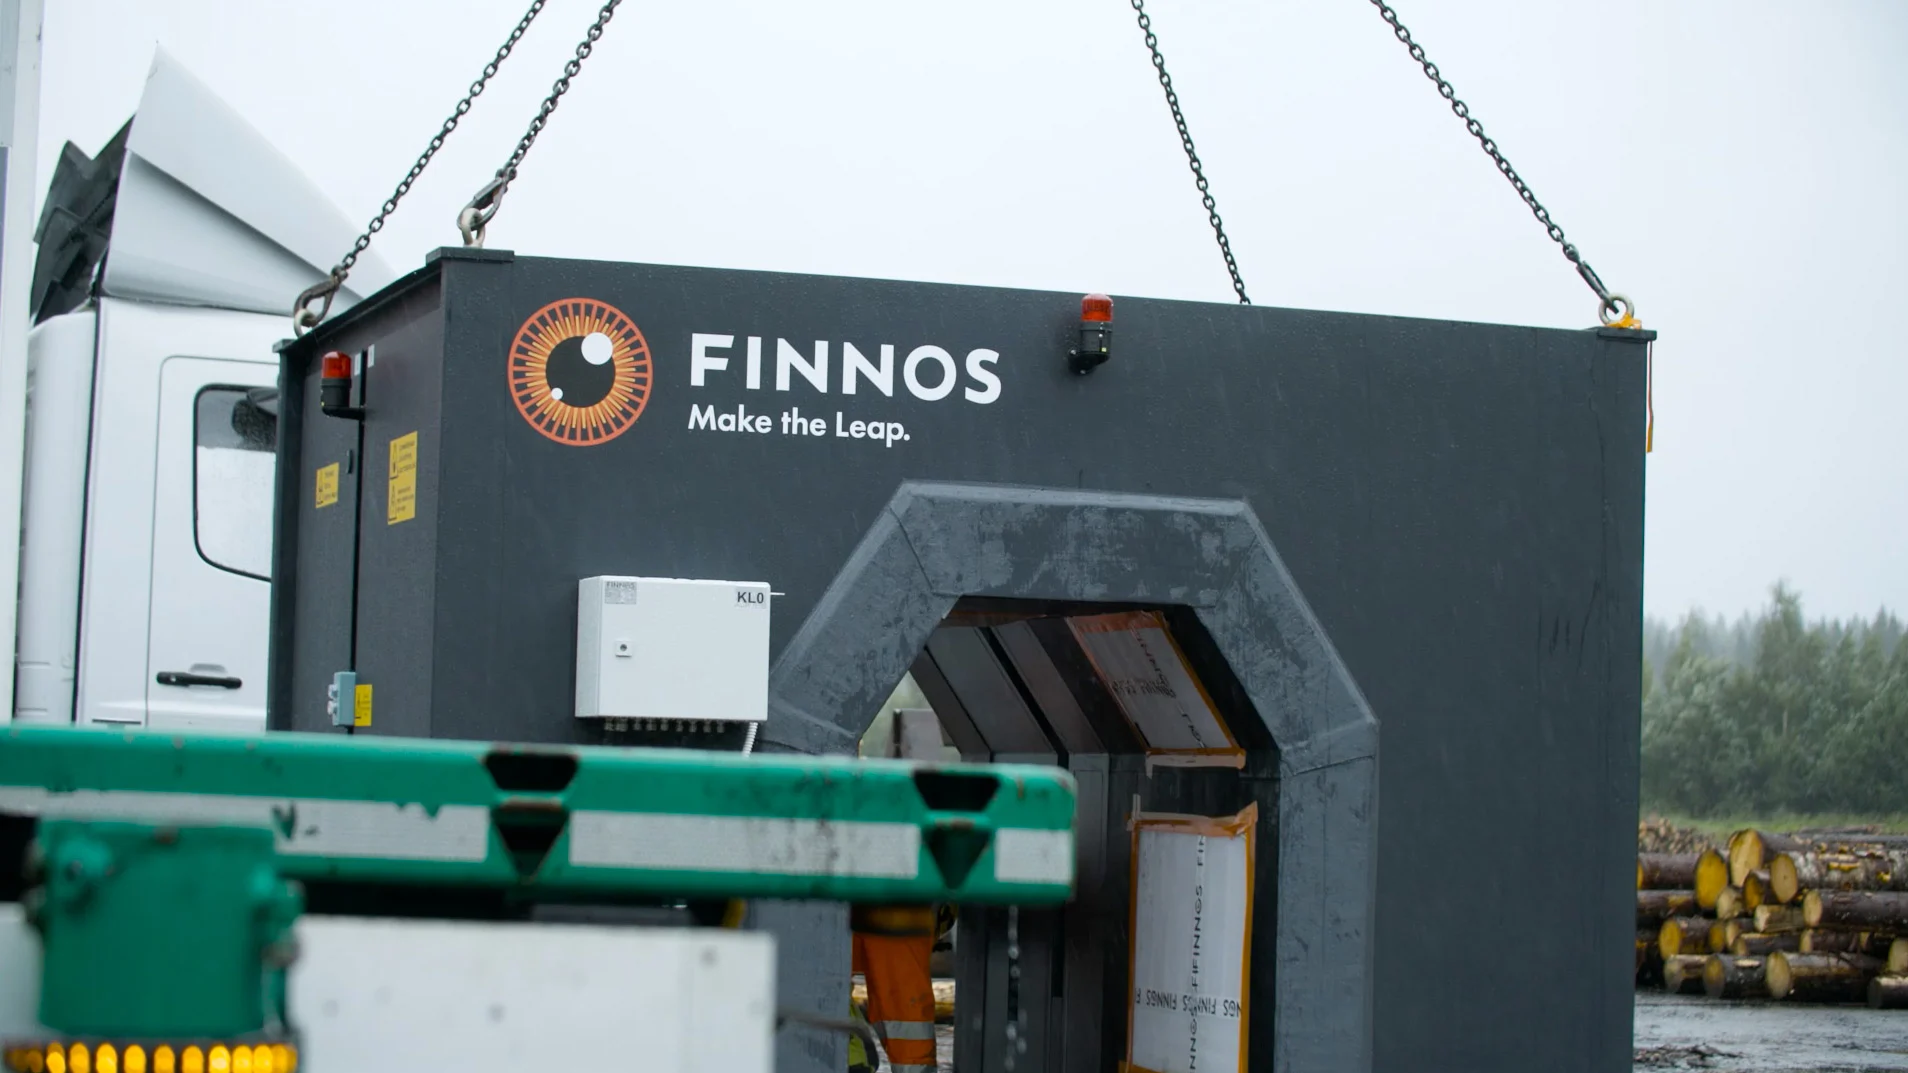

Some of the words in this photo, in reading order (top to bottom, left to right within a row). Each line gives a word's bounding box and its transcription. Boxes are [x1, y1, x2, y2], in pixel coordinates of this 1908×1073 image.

[690, 333, 1002, 404] FINNOS
[687, 404, 773, 433] Make
[781, 407, 827, 436] the
[835, 411, 911, 448] Leap.
